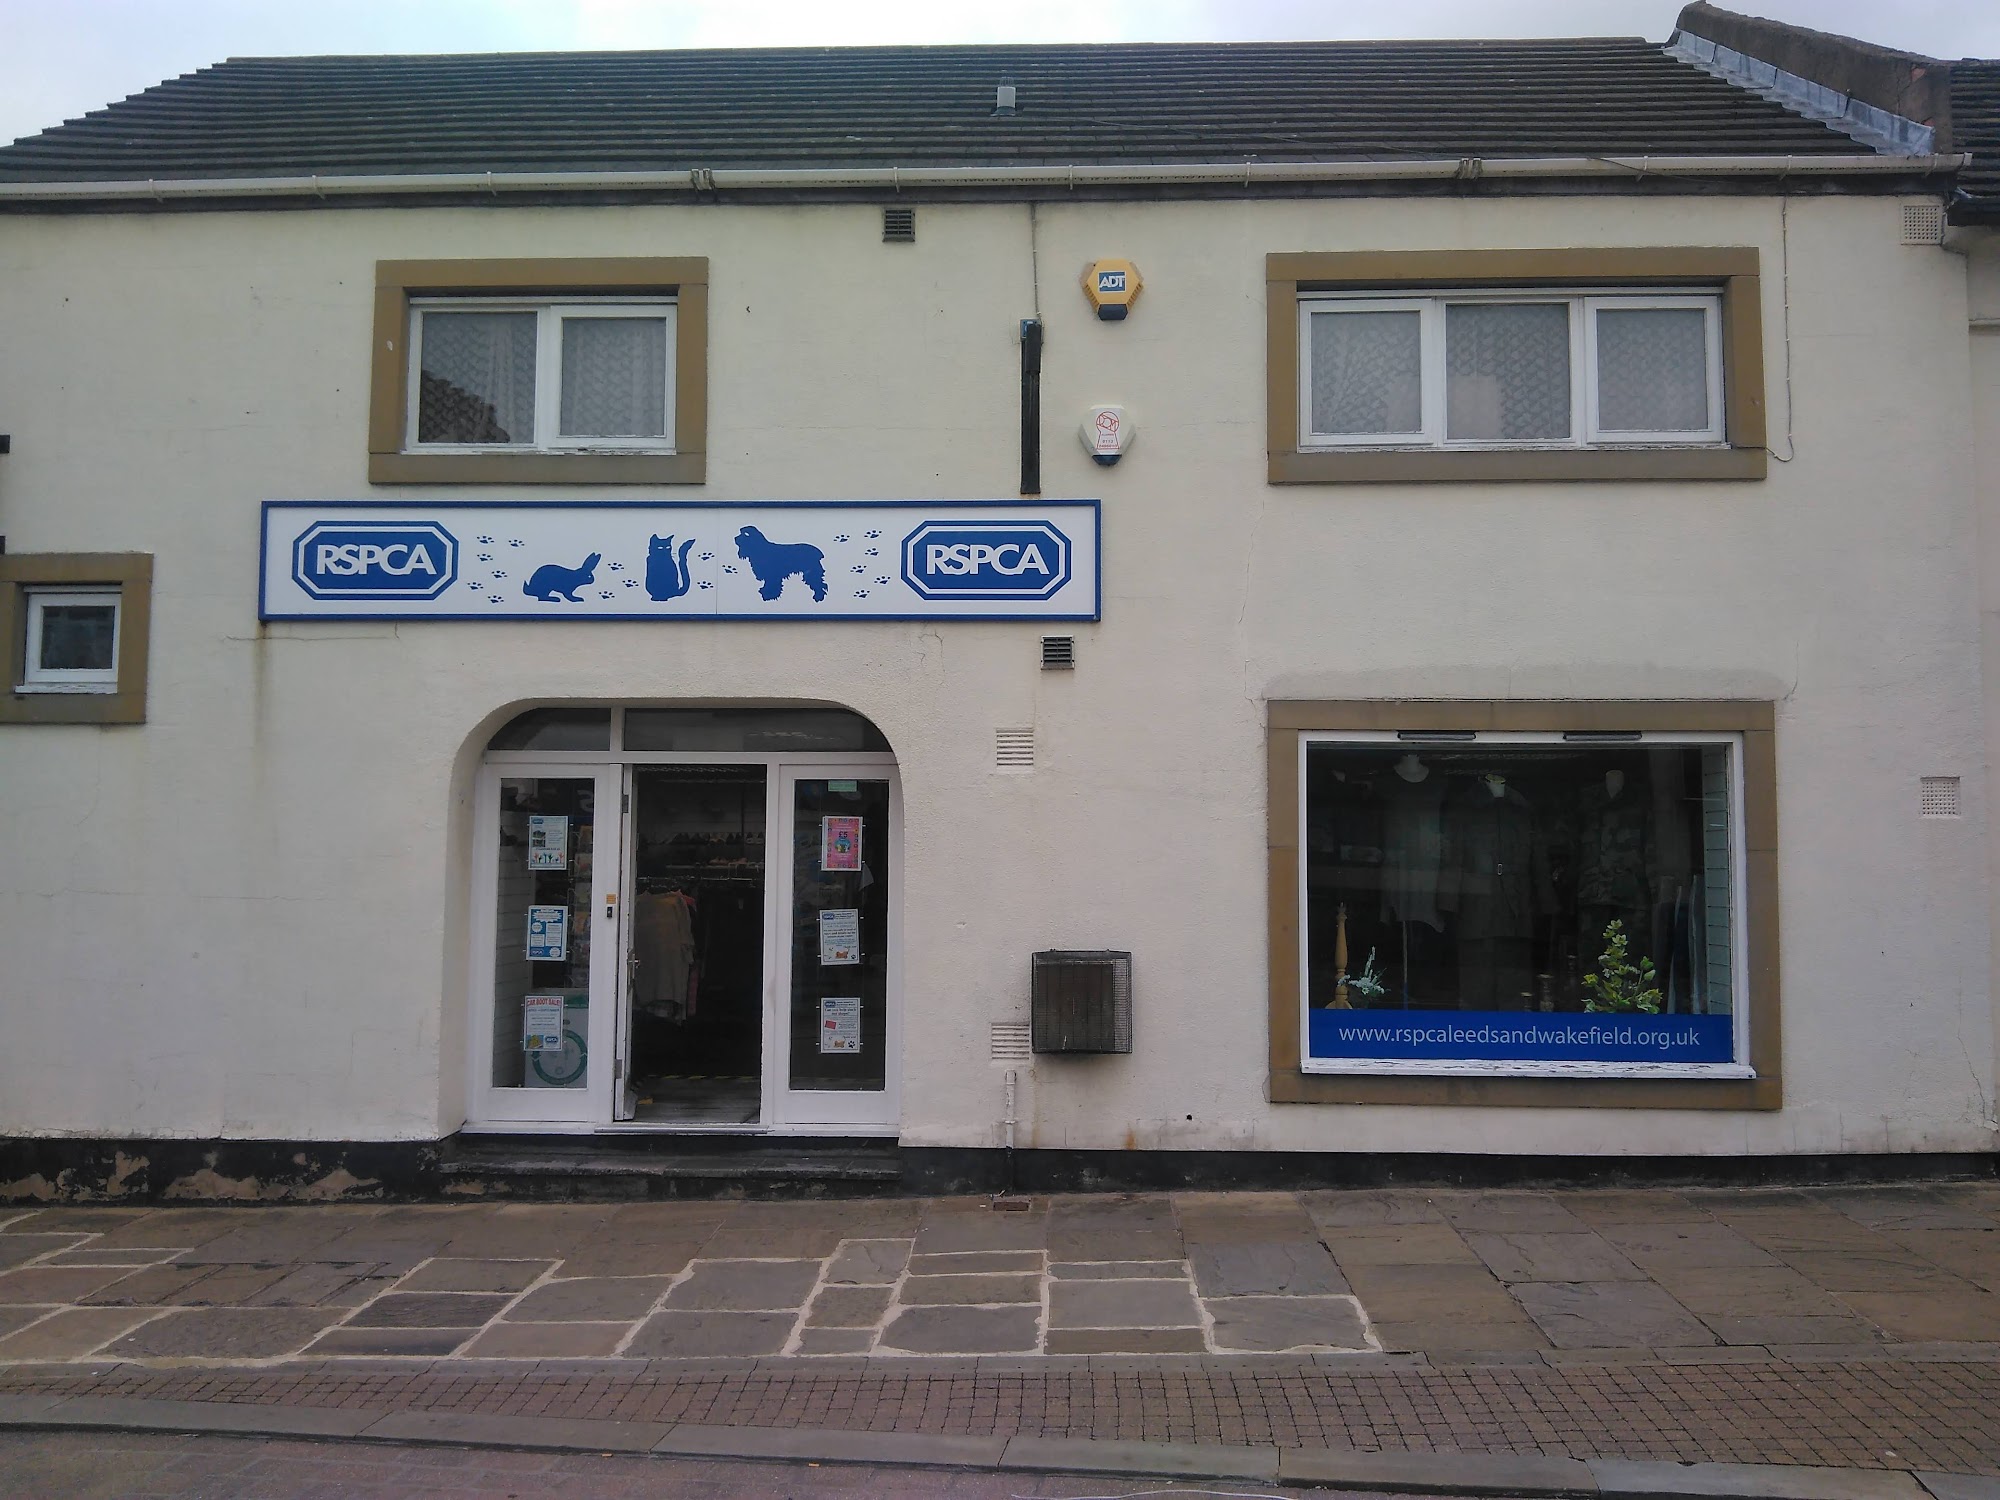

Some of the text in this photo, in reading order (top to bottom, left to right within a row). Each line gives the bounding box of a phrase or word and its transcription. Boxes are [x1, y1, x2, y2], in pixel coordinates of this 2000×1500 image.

[1099, 275, 1125, 288] ADT
[316, 543, 437, 576] RSPCA
[926, 543, 1050, 576] RSPCA
[1339, 1025, 1700, 1050] www.rspcaleedsandwakefield.org.uk
